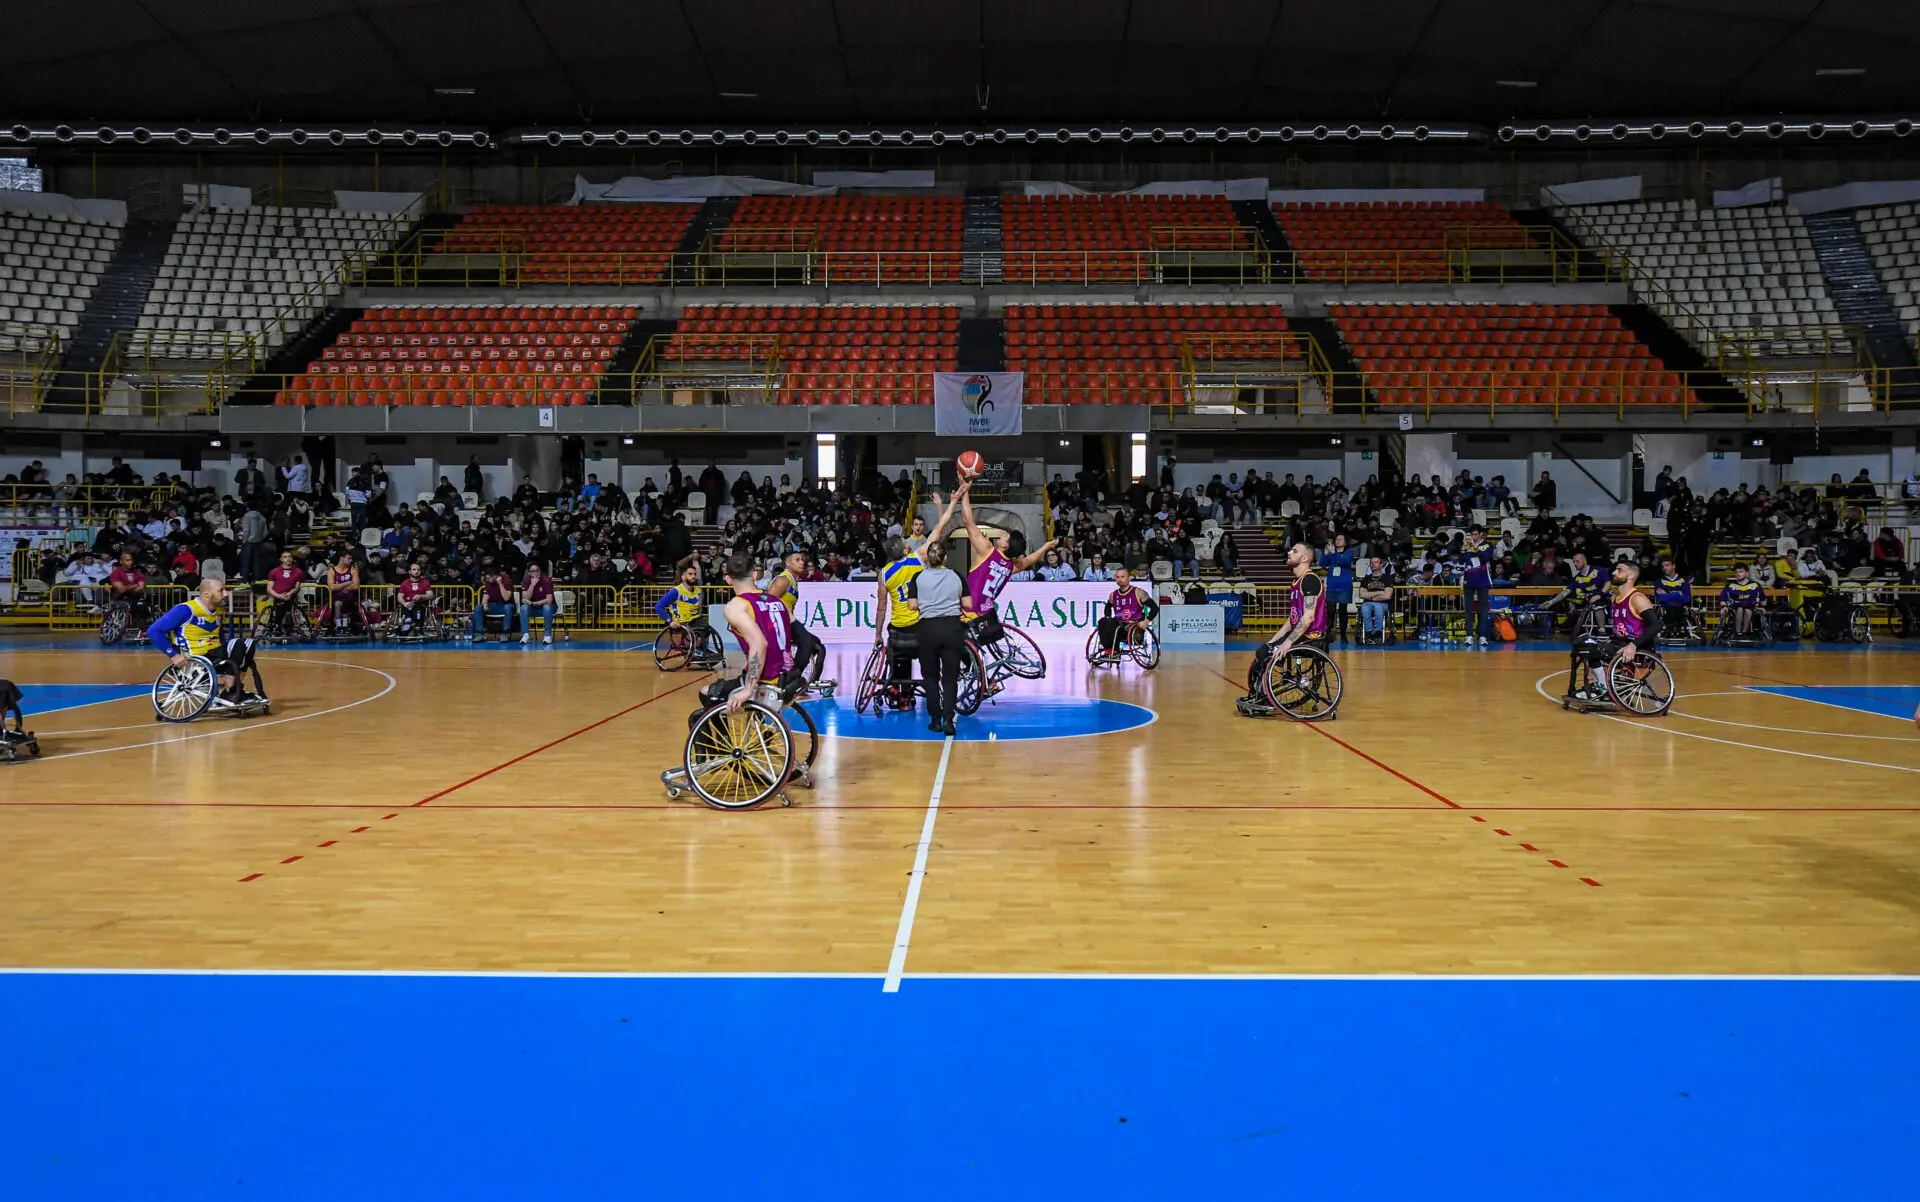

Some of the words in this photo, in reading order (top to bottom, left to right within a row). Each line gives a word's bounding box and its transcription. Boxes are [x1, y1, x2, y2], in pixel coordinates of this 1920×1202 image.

[543, 412, 549, 420] 4
[969, 418, 991, 426] IWBF
[983, 461, 1004, 470] sual
